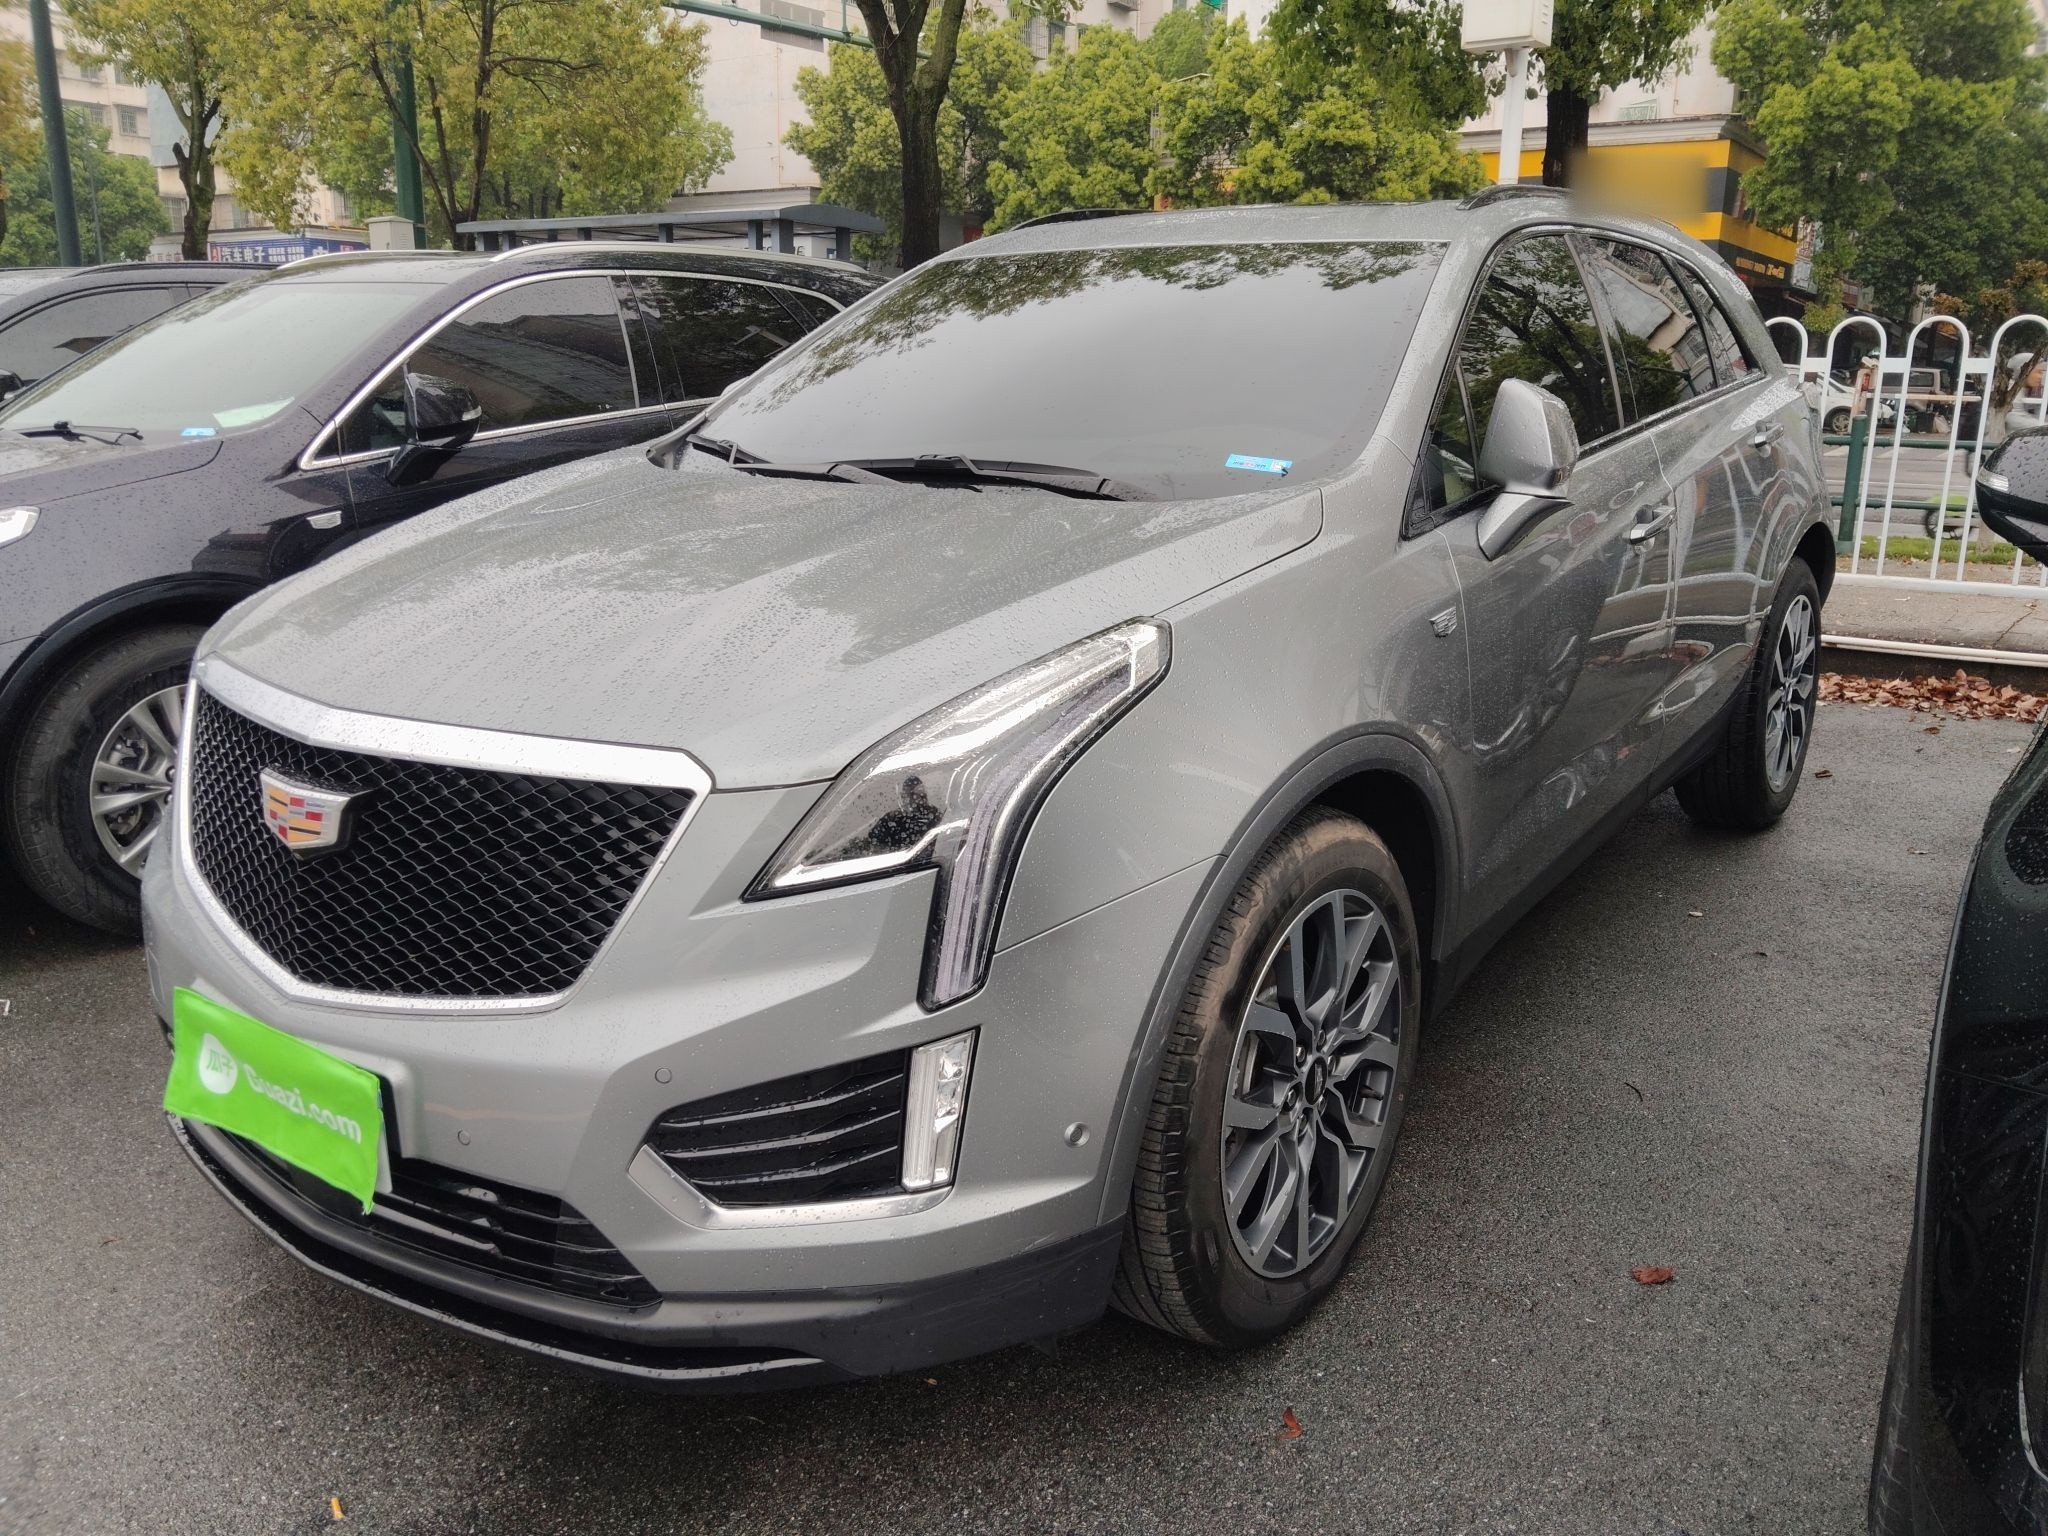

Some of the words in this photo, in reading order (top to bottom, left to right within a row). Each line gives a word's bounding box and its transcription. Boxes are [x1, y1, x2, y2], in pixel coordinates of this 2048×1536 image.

[221, 246, 266, 264] 汽车电子
[206, 1049, 234, 1077] 瓜子
[244, 1064, 361, 1144] Guazi.com
